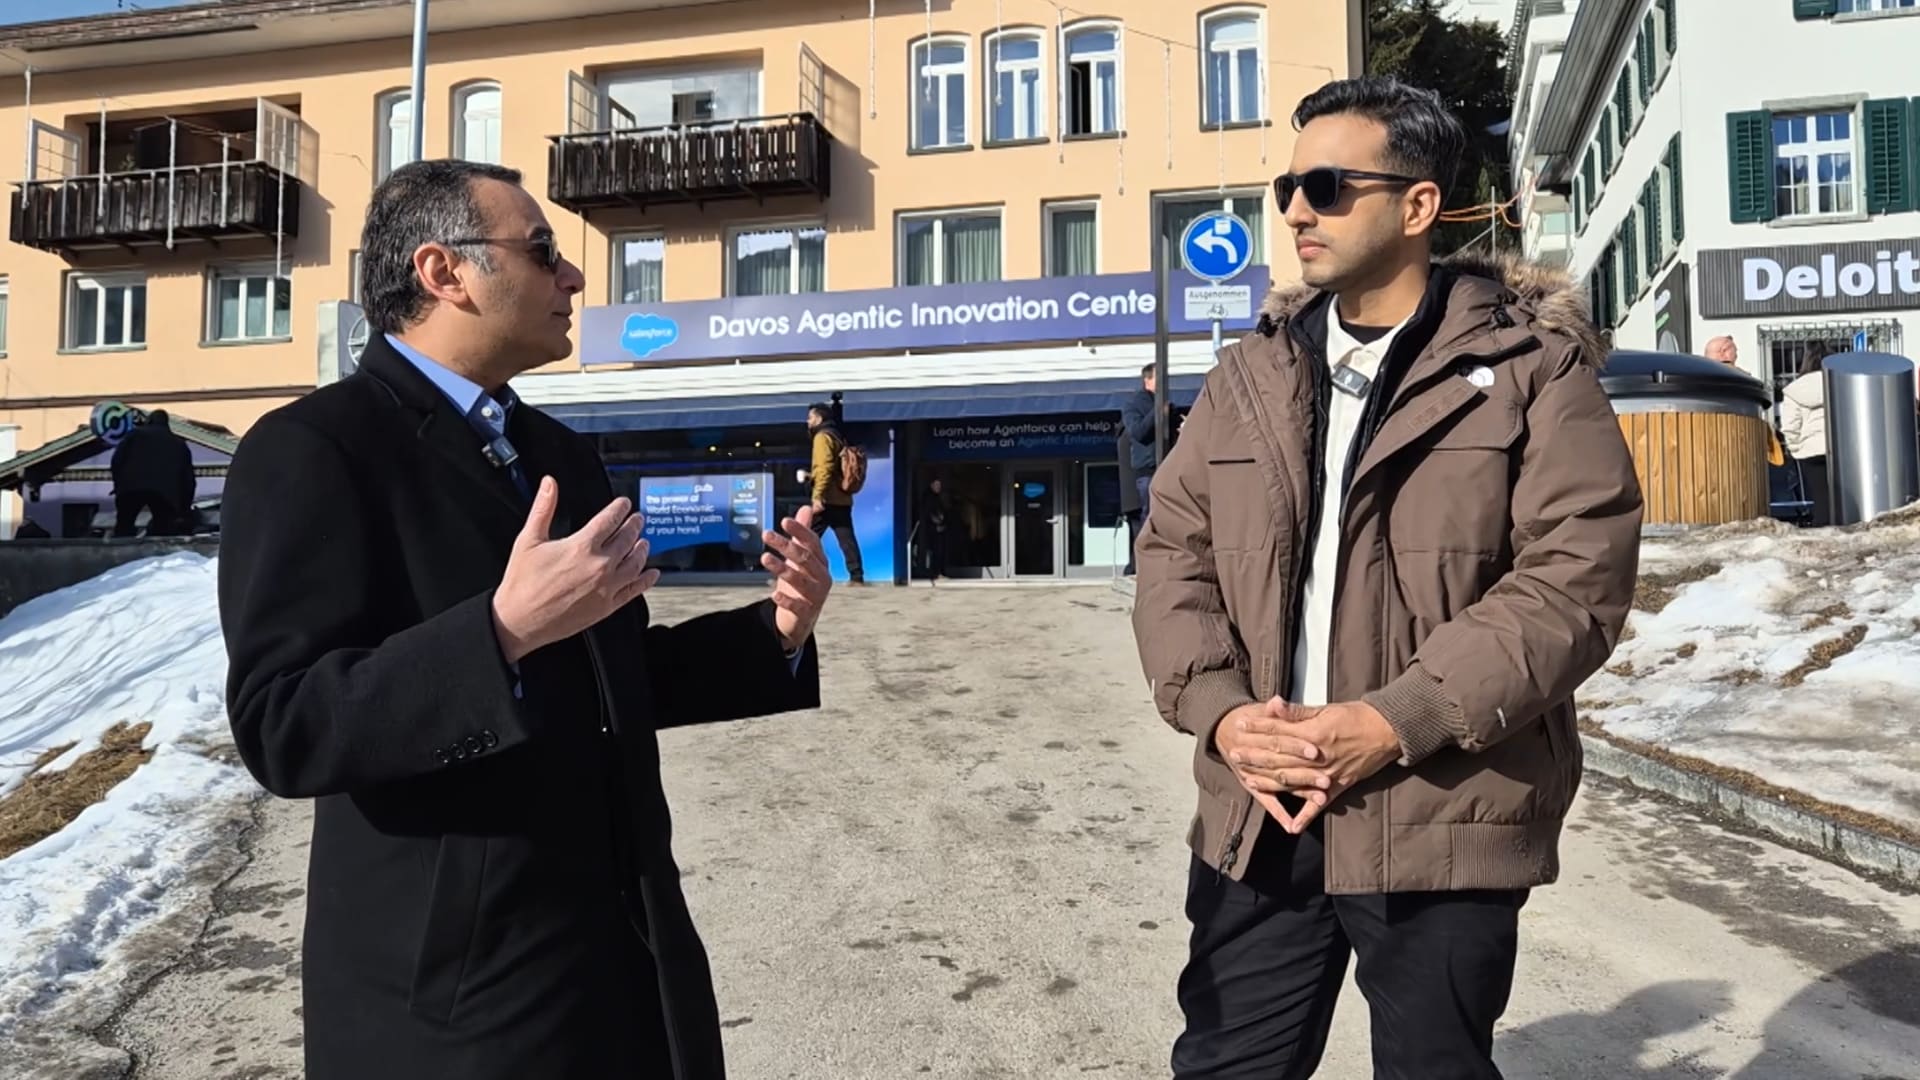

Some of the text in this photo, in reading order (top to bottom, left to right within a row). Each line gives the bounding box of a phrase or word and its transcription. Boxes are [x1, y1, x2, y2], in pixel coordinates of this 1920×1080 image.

[1743, 250, 1920, 301] Deloit
[1188, 290, 1248, 300] Ausgenommen
[709, 315, 789, 339] Davos
[797, 305, 903, 337] Agentic
[912, 296, 1058, 326] Innovation
[628, 327, 673, 340] salesforce
[933, 426, 965, 437] Learn
[967, 424, 991, 435] how
[993, 421, 1057, 438] Agentforce
[1059, 422, 1083, 433] can
[1085, 420, 1111, 434] help
[949, 438, 997, 449] become
[1000, 437, 1015, 448] an
[1017, 435, 1059, 448] Agentic
[646, 495, 661, 504] the
[690, 494, 700, 503] of
[646, 503, 715, 514] World Economic
[646, 515, 673, 525] Forum
[685, 515, 696, 524] the
[700, 514, 723, 525] palm
[646, 526, 656, 535] of
[656, 526, 676, 537] your
